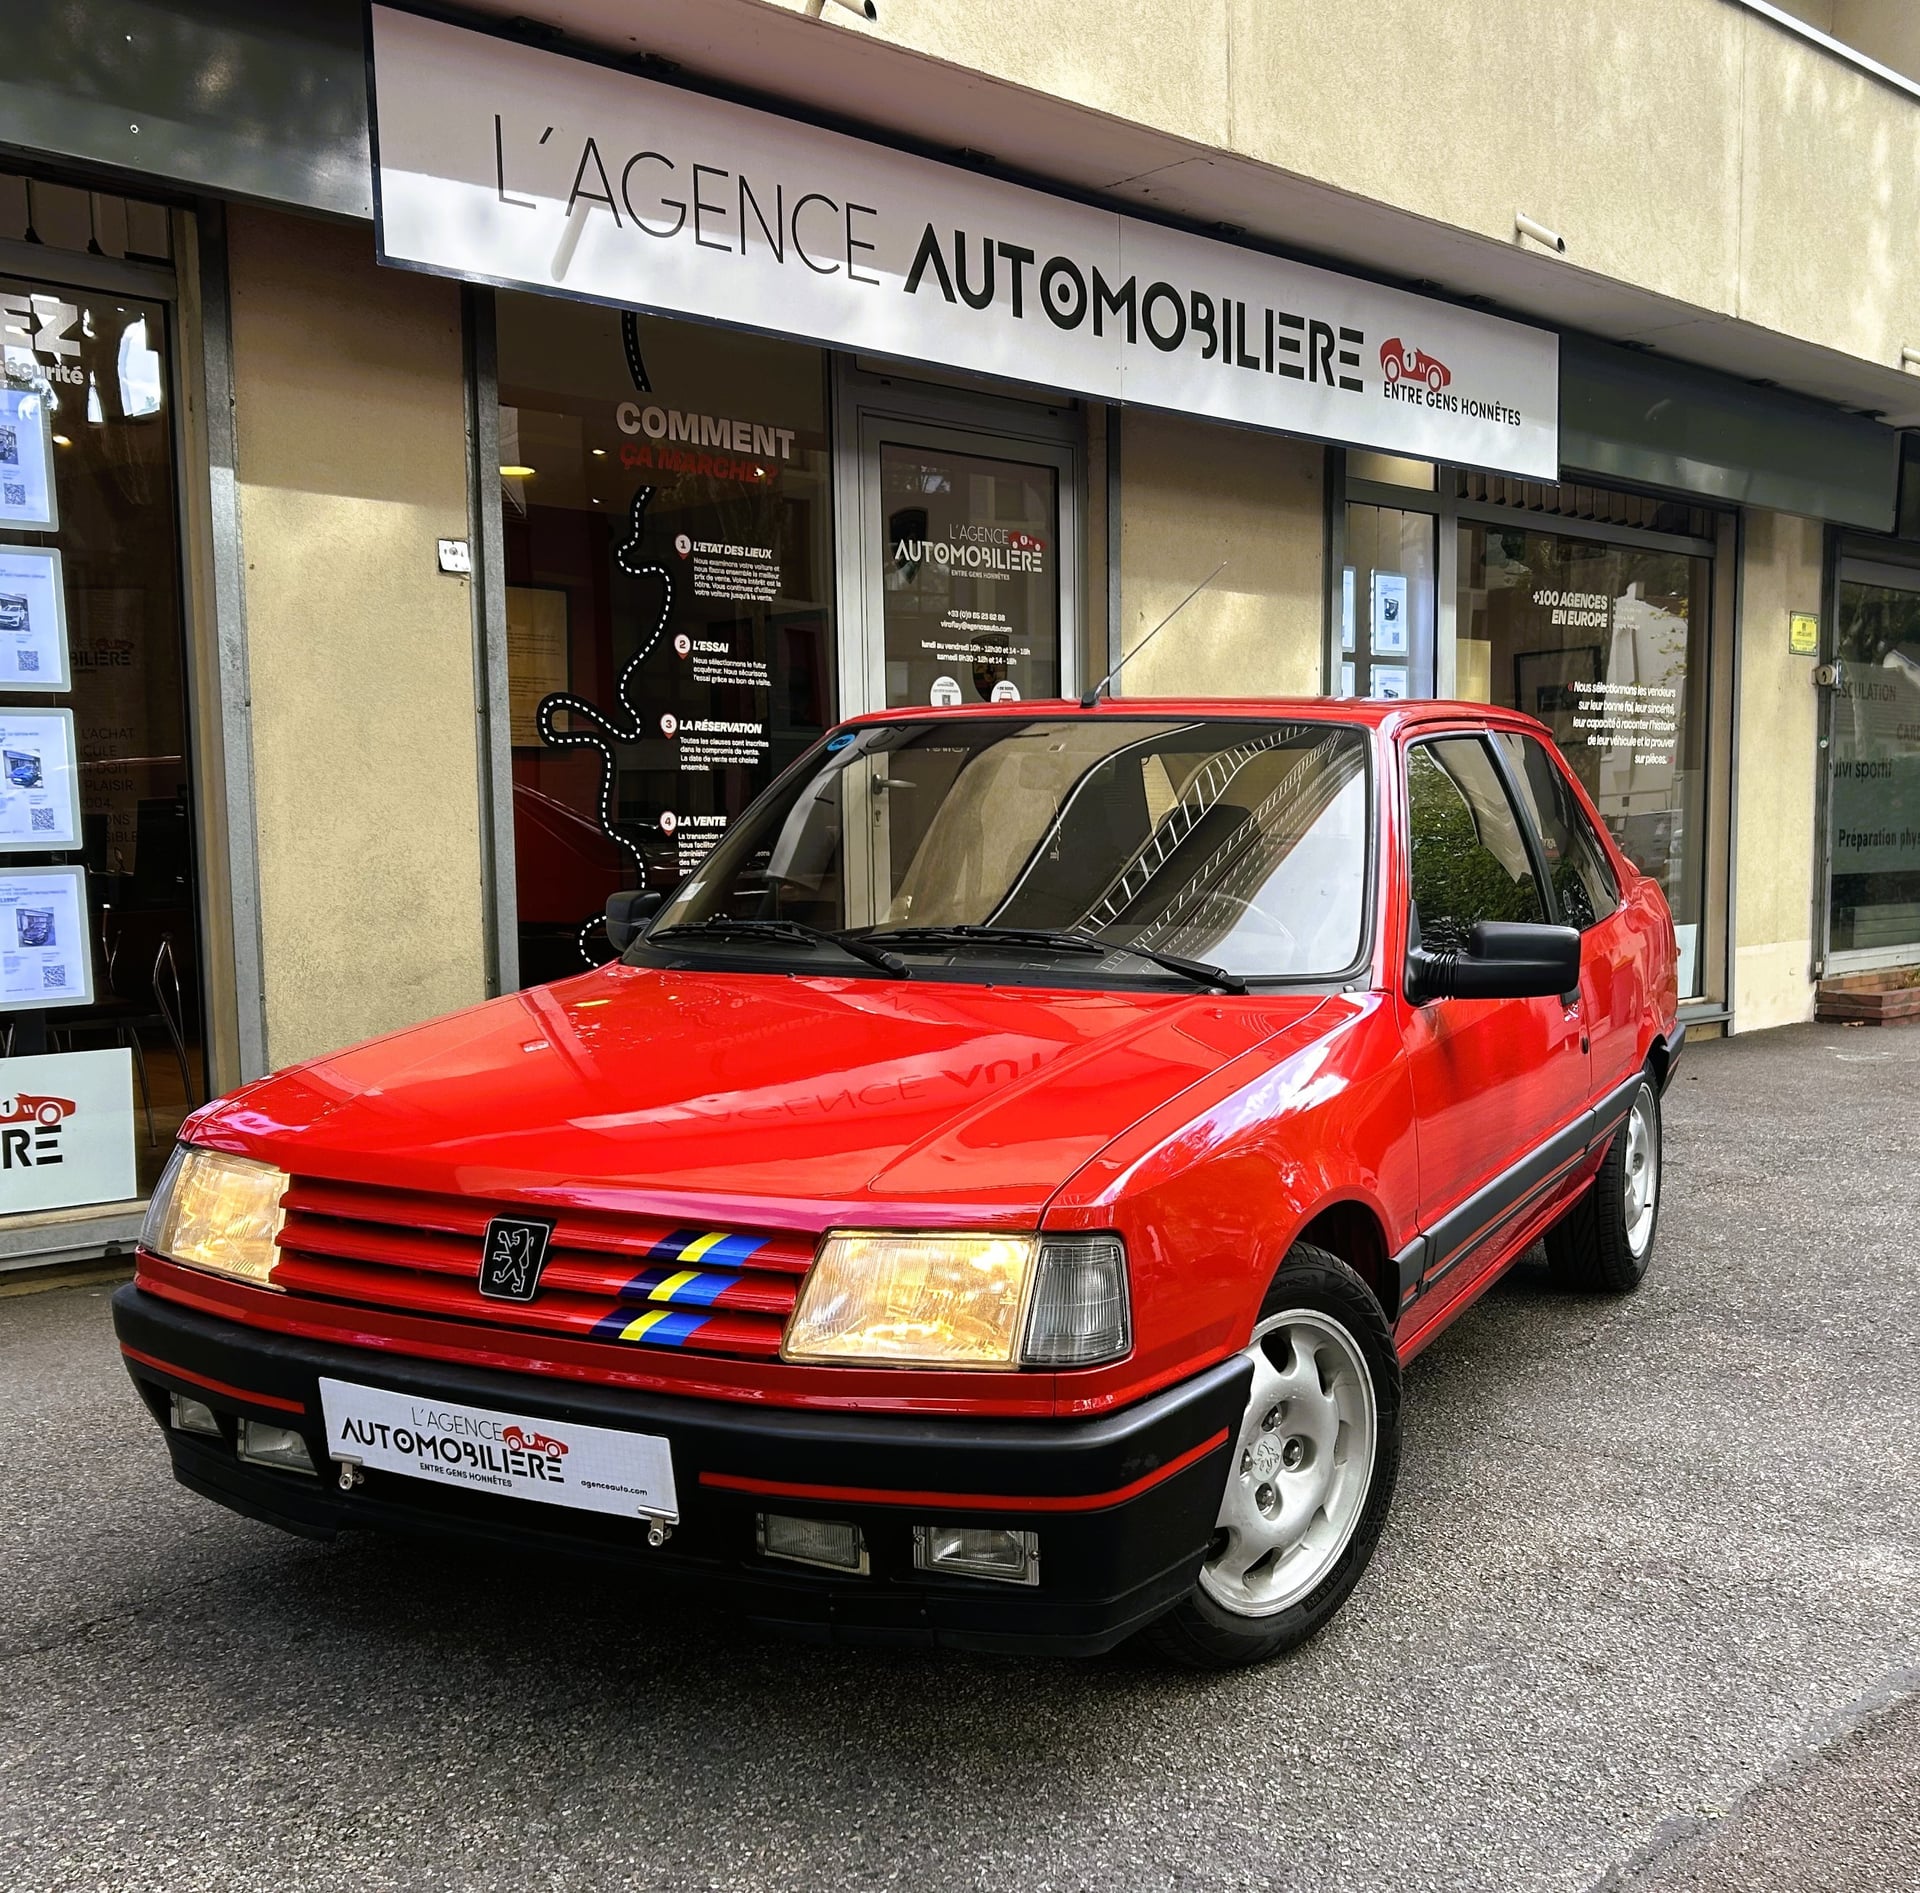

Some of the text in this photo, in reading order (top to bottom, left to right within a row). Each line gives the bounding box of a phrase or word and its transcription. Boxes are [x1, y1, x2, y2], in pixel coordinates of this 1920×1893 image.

[903, 222, 1365, 393] AUTOMOBILIERE
[1383, 381, 1521, 426] ENTRE GENS HONNÊTES
[616, 402, 795, 459] COMMENT
[620, 442, 653, 470] ÇA
[949, 523, 1009, 545] L'AGENCE
[693, 541, 773, 559] L'ETAT DES LIEUX
[895, 539, 1042, 573] AUTOMOBILIERE
[1533, 590, 1608, 611] +100 AGENCES
[1552, 610, 1567, 625] EN
[1568, 611, 1608, 628] EUROPE
[679, 640, 686, 649] 2
[693, 640, 729, 653] L'ESSAI
[1574, 681, 1591, 693] Nous
[1592, 682, 1637, 696] sélectionnons
[1638, 685, 1647, 696] les
[1578, 701, 1589, 711] sur
[1603, 701, 1624, 712] bonne
[665, 720, 672, 728] 3
[680, 719, 762, 734] LA RÉSERVATION
[1635, 754, 1645, 764] sur
[665, 817, 672, 827] 4
[678, 816, 727, 827] LA VENTE
[1838, 827, 1897, 852] Préparation
[411, 1406, 505, 1442] L'AGENCE
[341, 1417, 565, 1484] AUTOMOBILIERE
[420, 1462, 513, 1488] ENTRE GENS HONNÊTES
[580, 1480, 648, 1496] agenceauto.com
